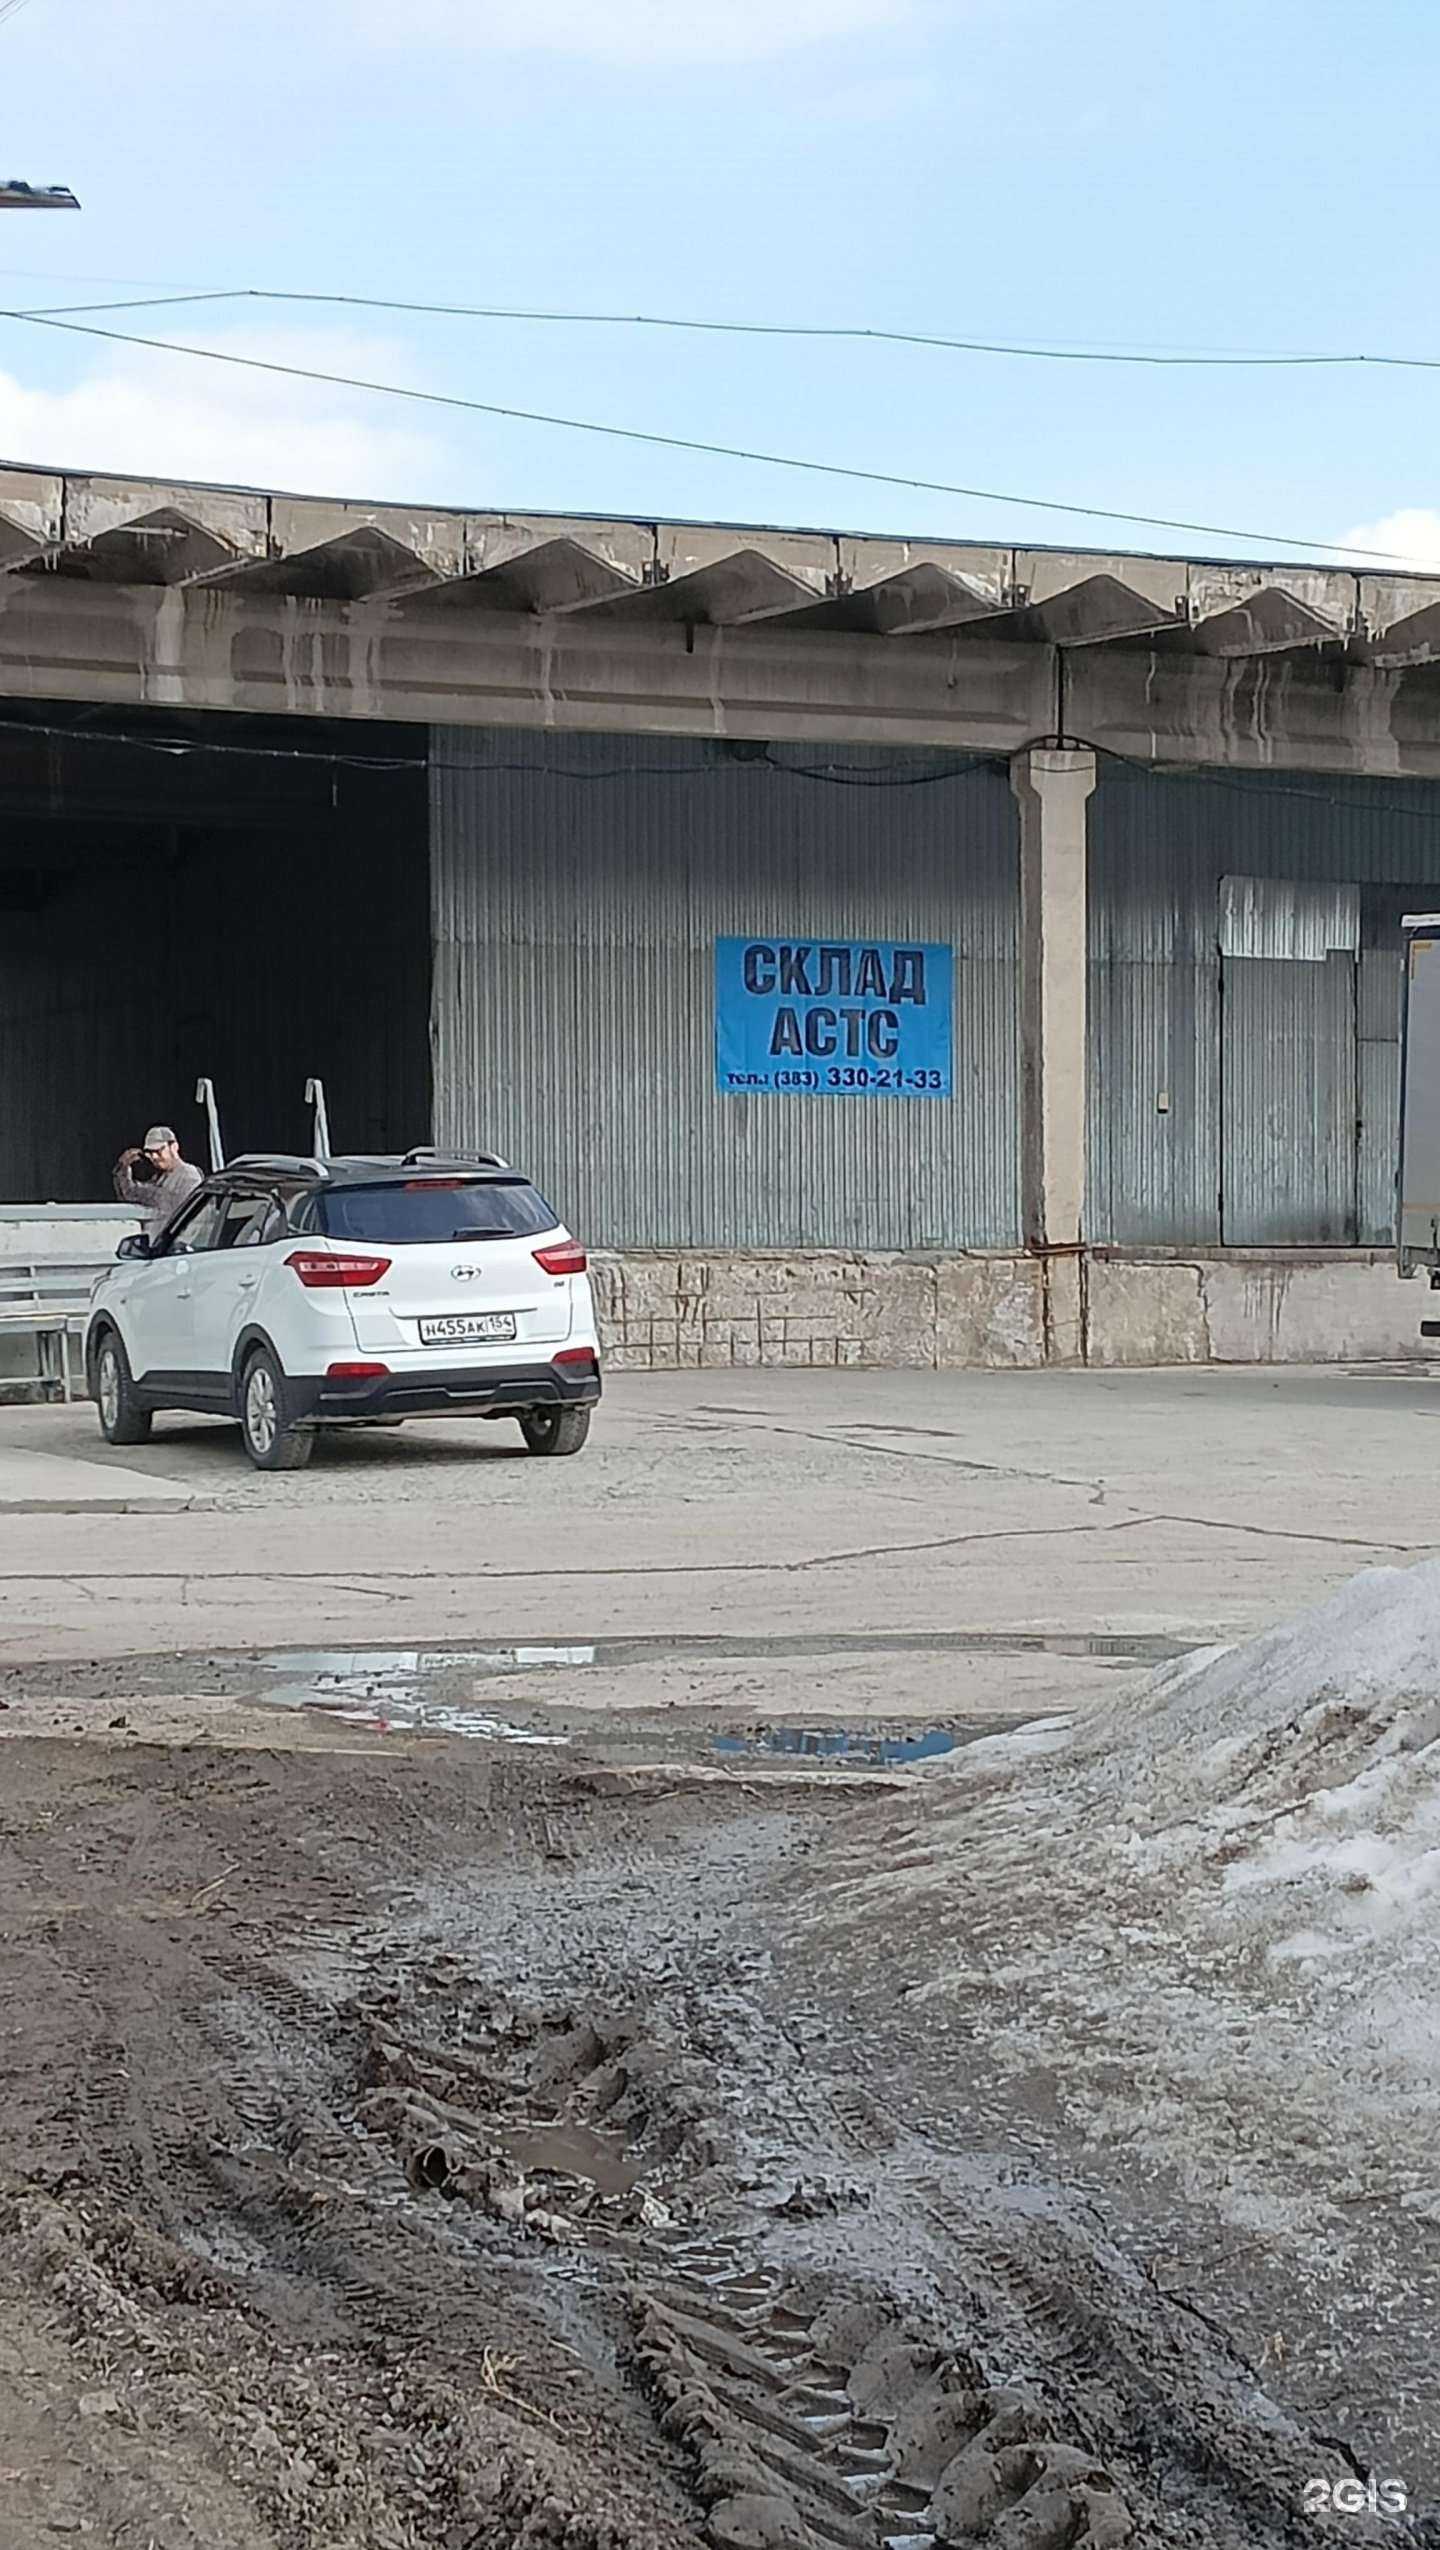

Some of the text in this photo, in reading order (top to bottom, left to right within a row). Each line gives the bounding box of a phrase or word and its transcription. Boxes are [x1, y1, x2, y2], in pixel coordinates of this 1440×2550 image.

[743, 944, 926, 1005] СКЛАД
[770, 1007, 899, 1058] АСТС
[774, 1070, 819, 1090] (383)
[827, 1067, 942, 1089] 330-21-33
